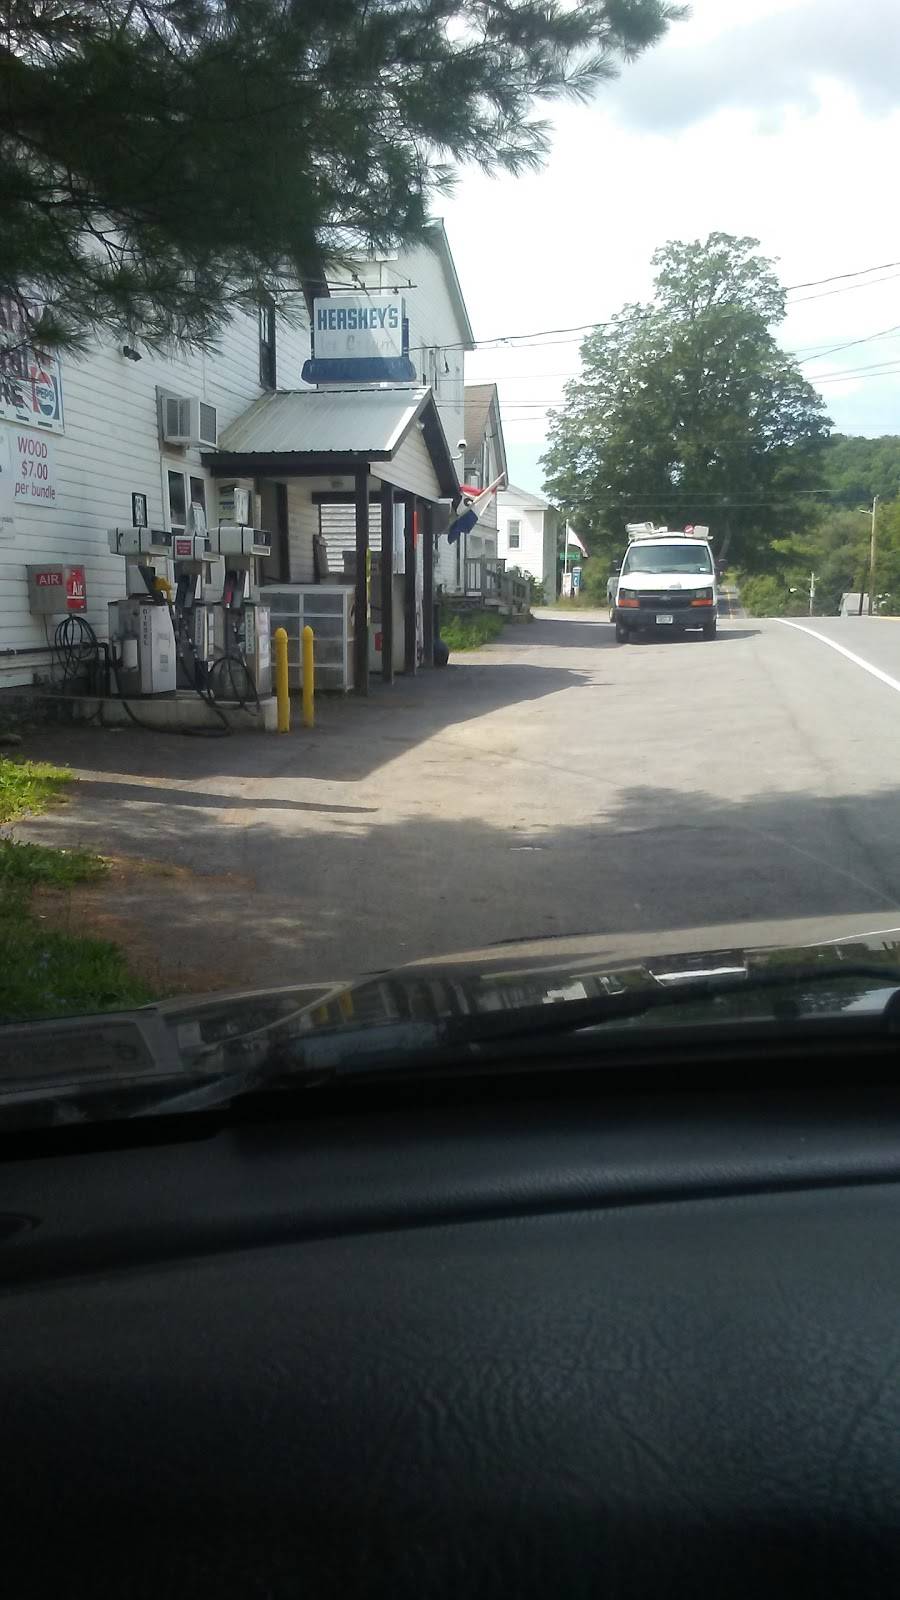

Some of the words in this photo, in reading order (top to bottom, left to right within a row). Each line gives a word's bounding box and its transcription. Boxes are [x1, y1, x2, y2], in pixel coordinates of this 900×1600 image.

[317, 304, 398, 330] HERSHEY'S
[17, 436, 48, 458] WOOD
[21, 460, 48, 480] $7.00
[15, 482, 29, 496] per
[31, 482, 56, 499] bundle
[39, 574, 60, 585] AIR
[72, 580, 83, 596] Air
